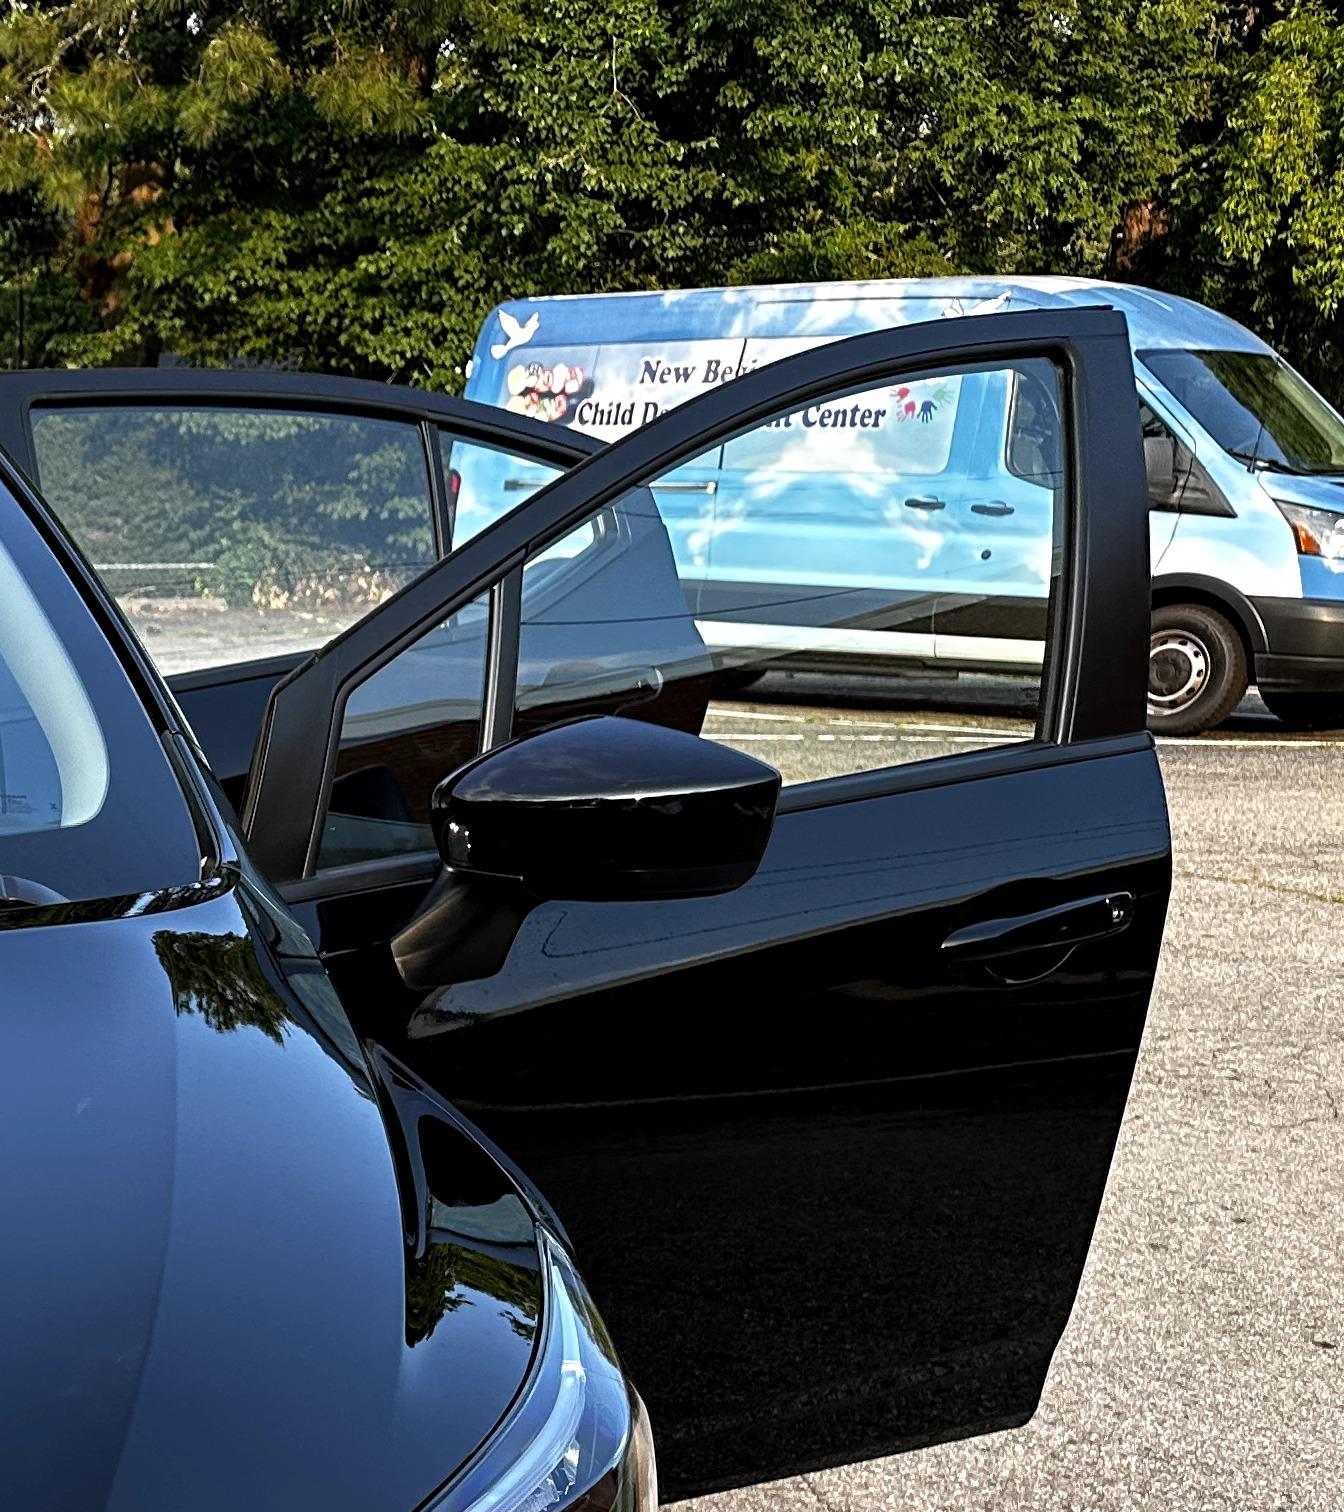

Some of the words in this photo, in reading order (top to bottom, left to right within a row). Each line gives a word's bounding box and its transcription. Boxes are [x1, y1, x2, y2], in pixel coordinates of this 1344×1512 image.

[639, 360, 696, 384] New
[578, 402, 636, 426] Child
[802, 403, 887, 428] Center
